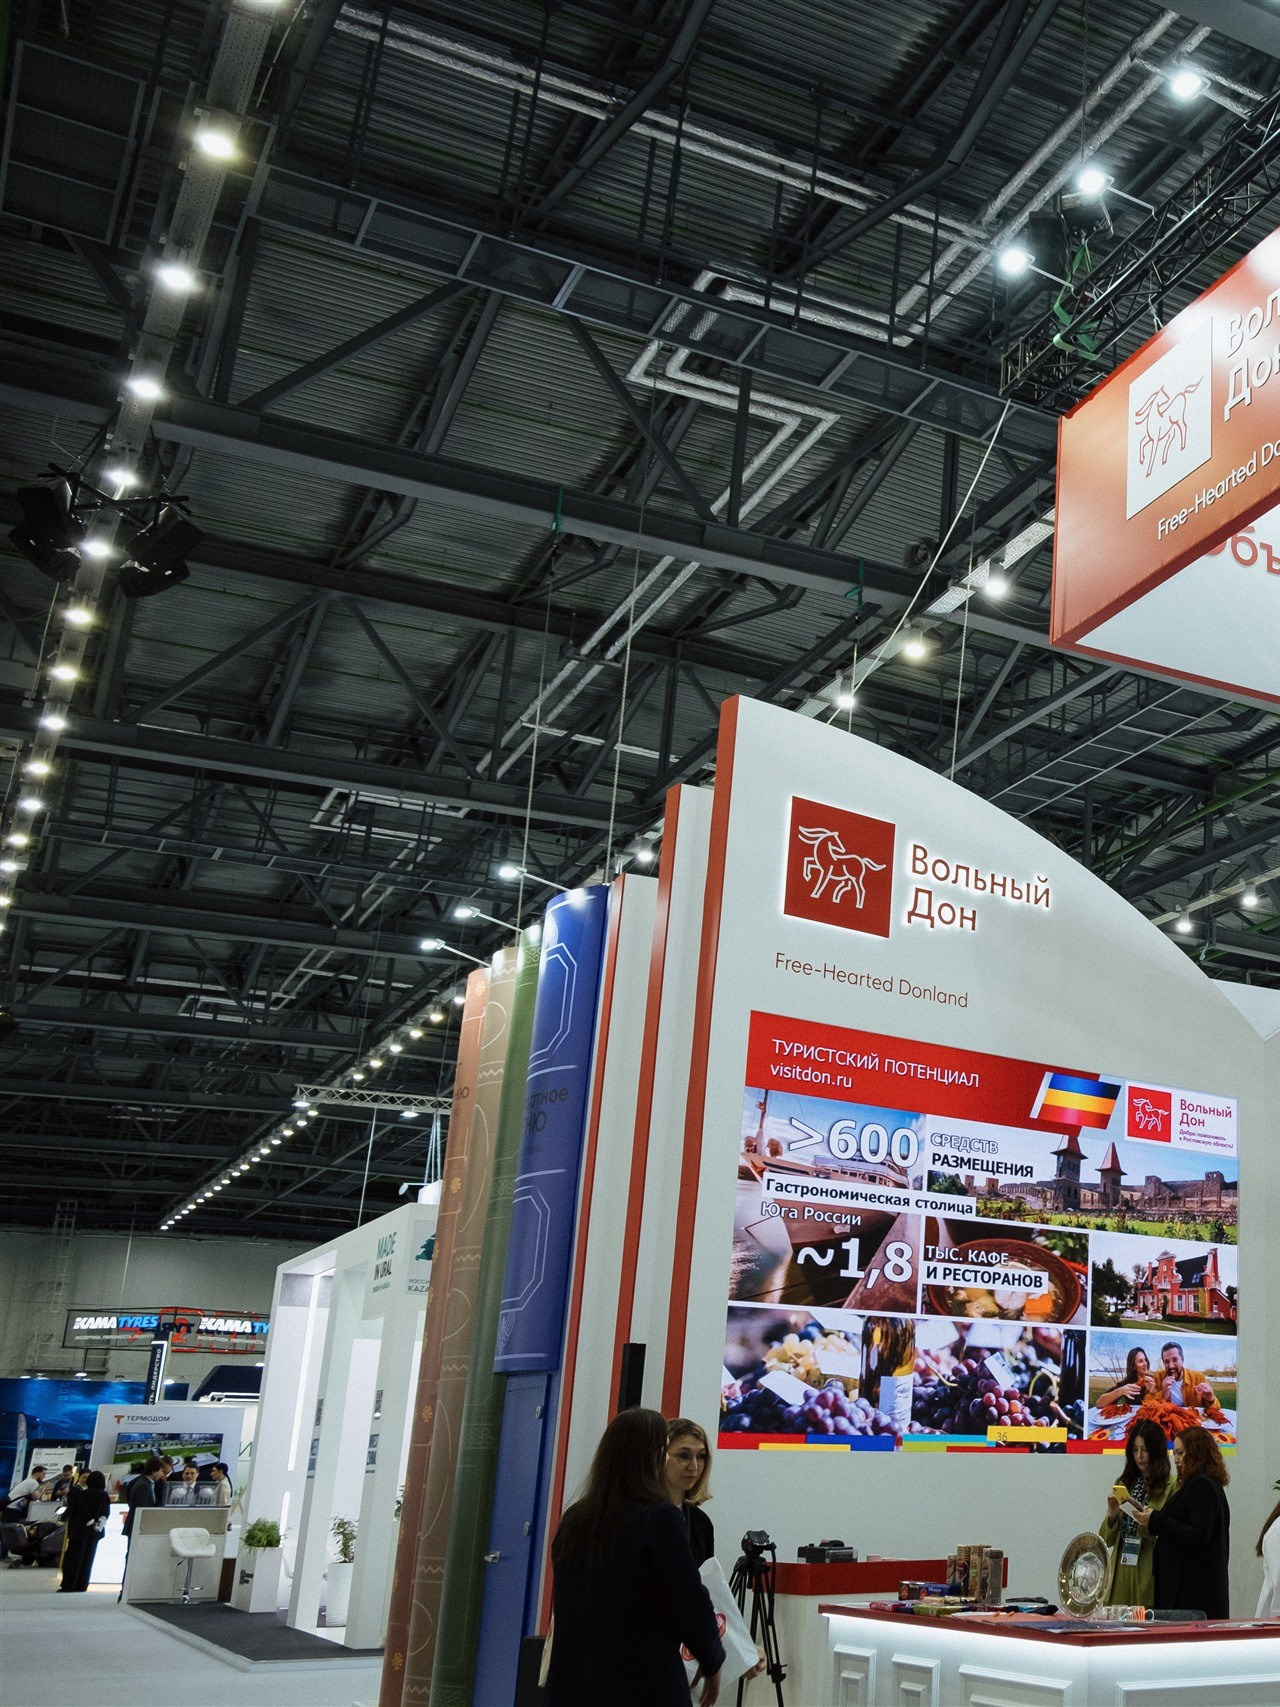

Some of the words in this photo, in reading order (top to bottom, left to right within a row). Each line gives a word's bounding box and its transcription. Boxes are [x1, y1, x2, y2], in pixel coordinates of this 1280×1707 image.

[1157, 450, 1258, 541] Free-Hearted
[912, 844, 1050, 908] Вольный
[907, 887, 977, 931] Дон
[775, 952, 893, 992] Free-Hearted
[899, 979, 968, 1008] Donland
[770, 1063, 853, 1088] visitdon.ru
[771, 1039, 879, 1071] ТУРИСТСКИЙ
[884, 1059, 979, 1088] ПОТЕНЦИАЛ
[1179, 1113, 1205, 1127] Дон
[1180, 1098, 1232, 1118] Вольный
[931, 1132, 999, 1155] СРЕДСТВ
[932, 1152, 1034, 1178] РАЗМЕЩЕНИЯ
[766, 1178, 910, 1208] Гастрономическая
[915, 1199, 973, 1215] столица
[762, 1202, 798, 1220] Юга
[803, 1206, 862, 1226] России
[925, 1245, 964, 1261] ТЫС.
[968, 1250, 1009, 1266] КАФЕ
[926, 1266, 938, 1279] И
[942, 1267, 1043, 1288] РЕСТОРАНОВ
[73, 1316, 117, 1329] KAMA
[118, 1316, 159, 1328] TYRES
[199, 1317, 252, 1332] KAMA
[997, 1432, 1008, 1441] 36
